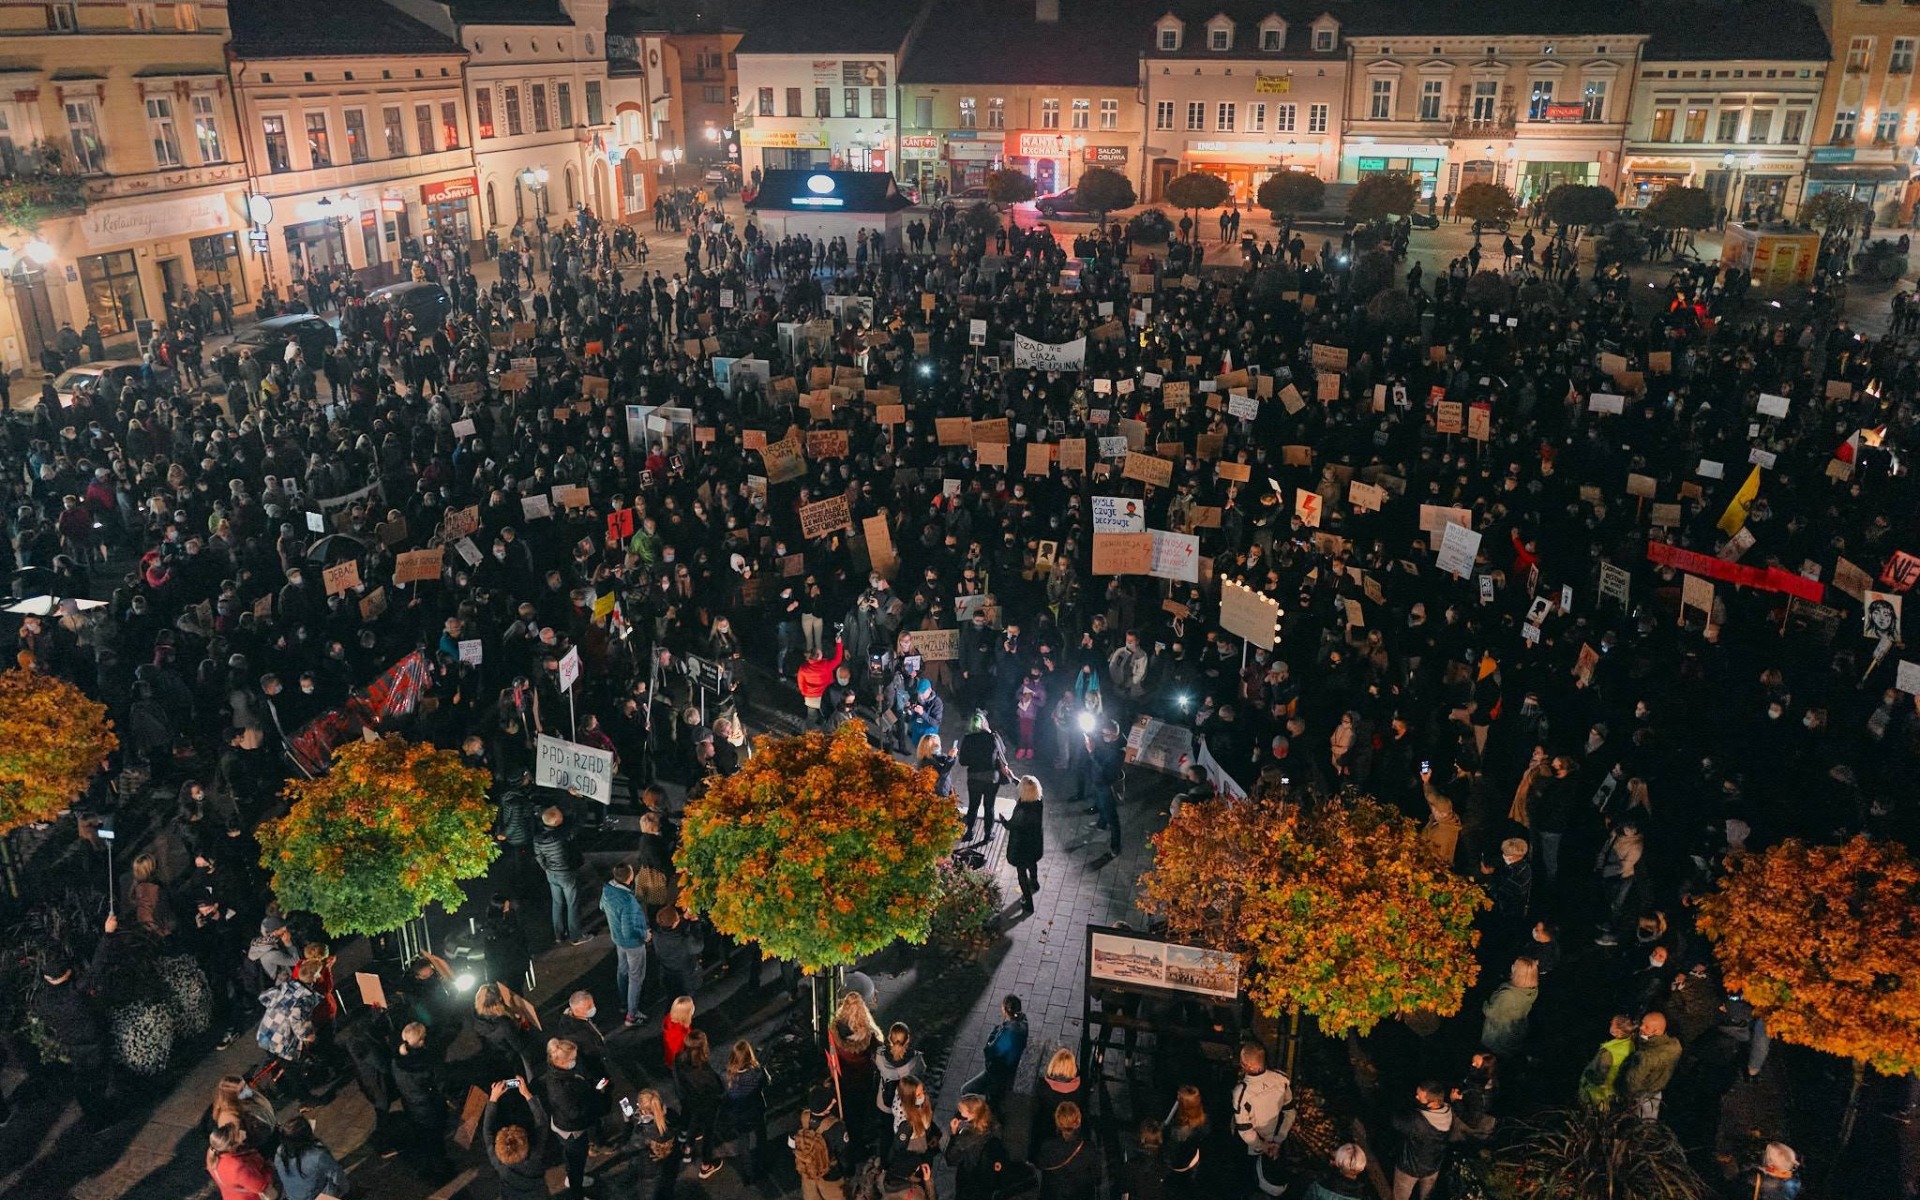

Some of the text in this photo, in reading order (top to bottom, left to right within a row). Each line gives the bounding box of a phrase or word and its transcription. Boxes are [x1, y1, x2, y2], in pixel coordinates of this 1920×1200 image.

[428, 186, 475, 202] KOSMYK
[542, 745, 564, 764] PAD
[550, 767, 569, 787] POD
